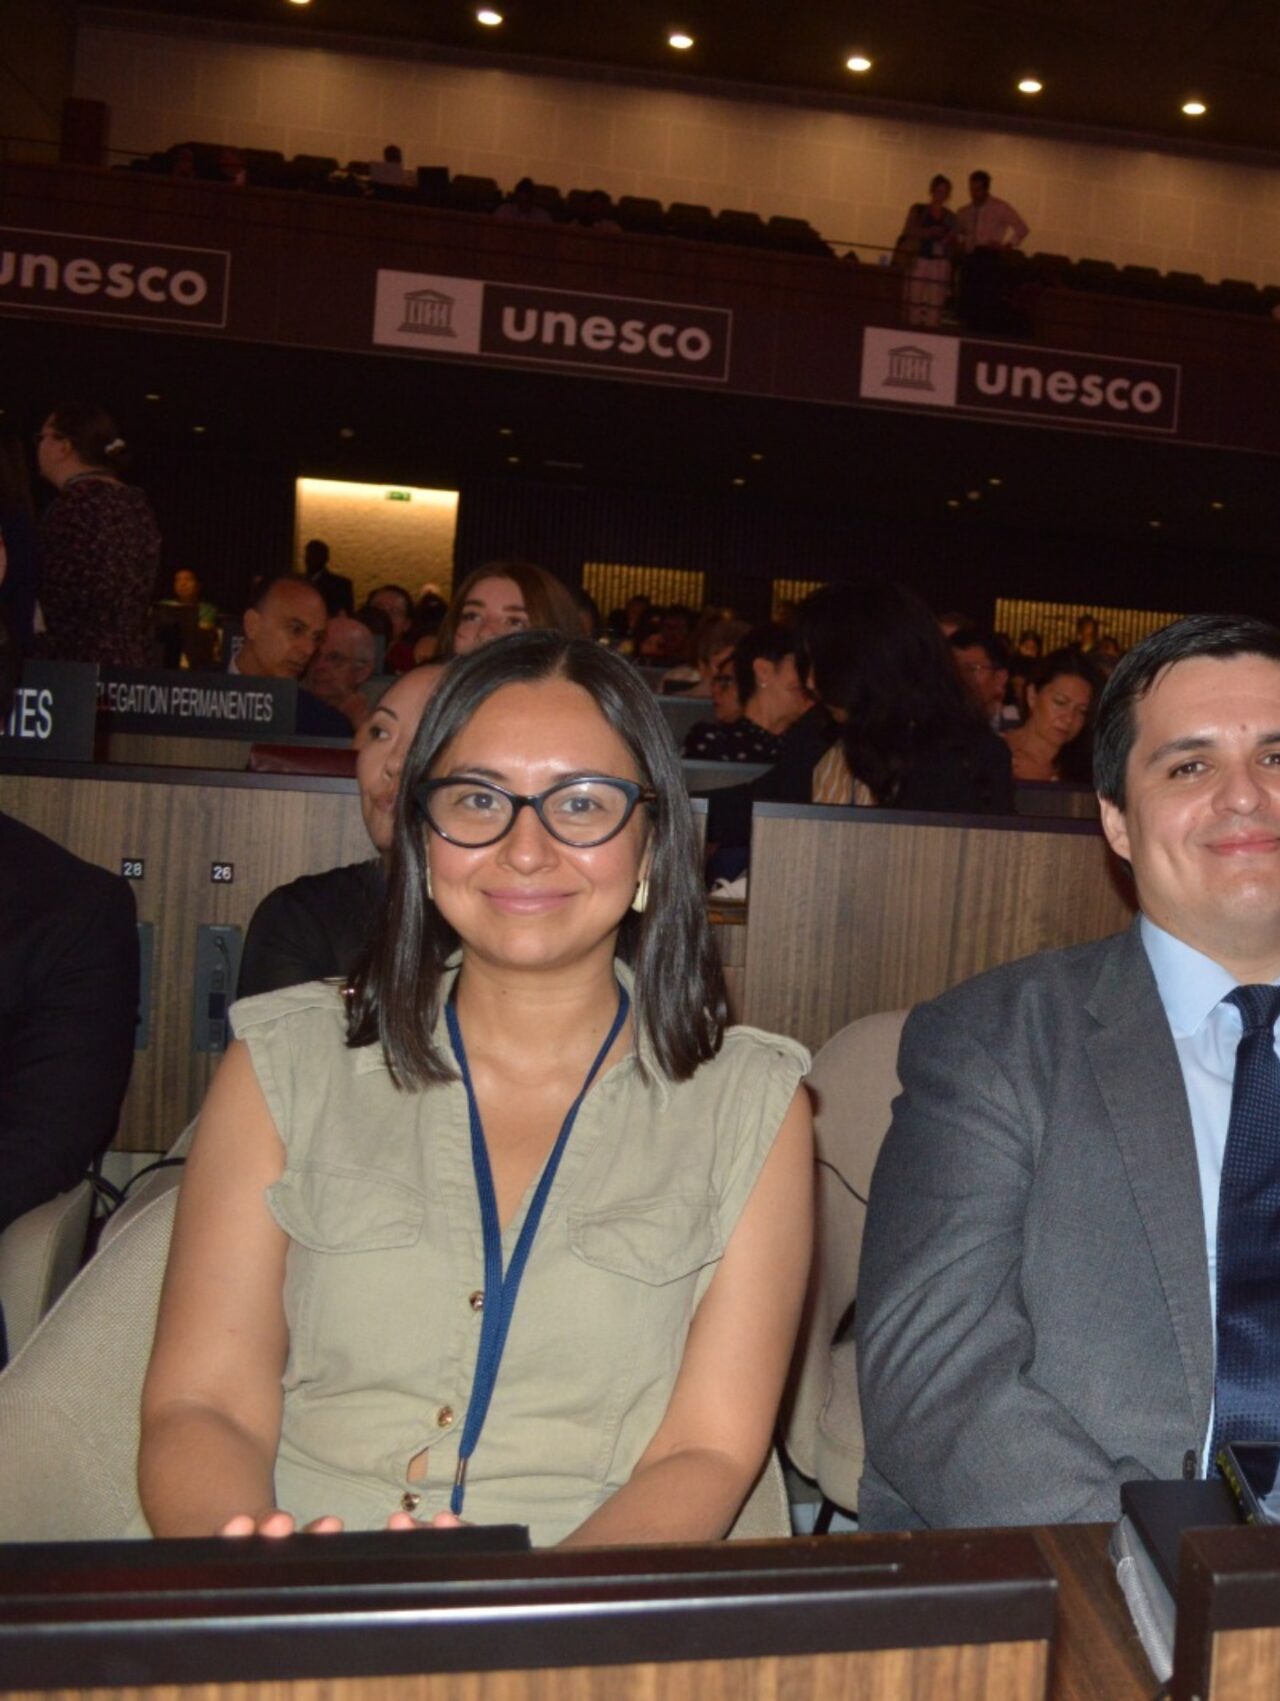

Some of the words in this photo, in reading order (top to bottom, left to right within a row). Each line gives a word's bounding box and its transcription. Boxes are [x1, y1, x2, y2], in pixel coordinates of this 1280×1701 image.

[502, 306, 712, 361] unesco
[975, 361, 1162, 413] unesco
[0, 687, 54, 739] TES
[171, 687, 273, 722] PERMANENTES
[123, 861, 143, 877] 28
[212, 865, 233, 881] 26
